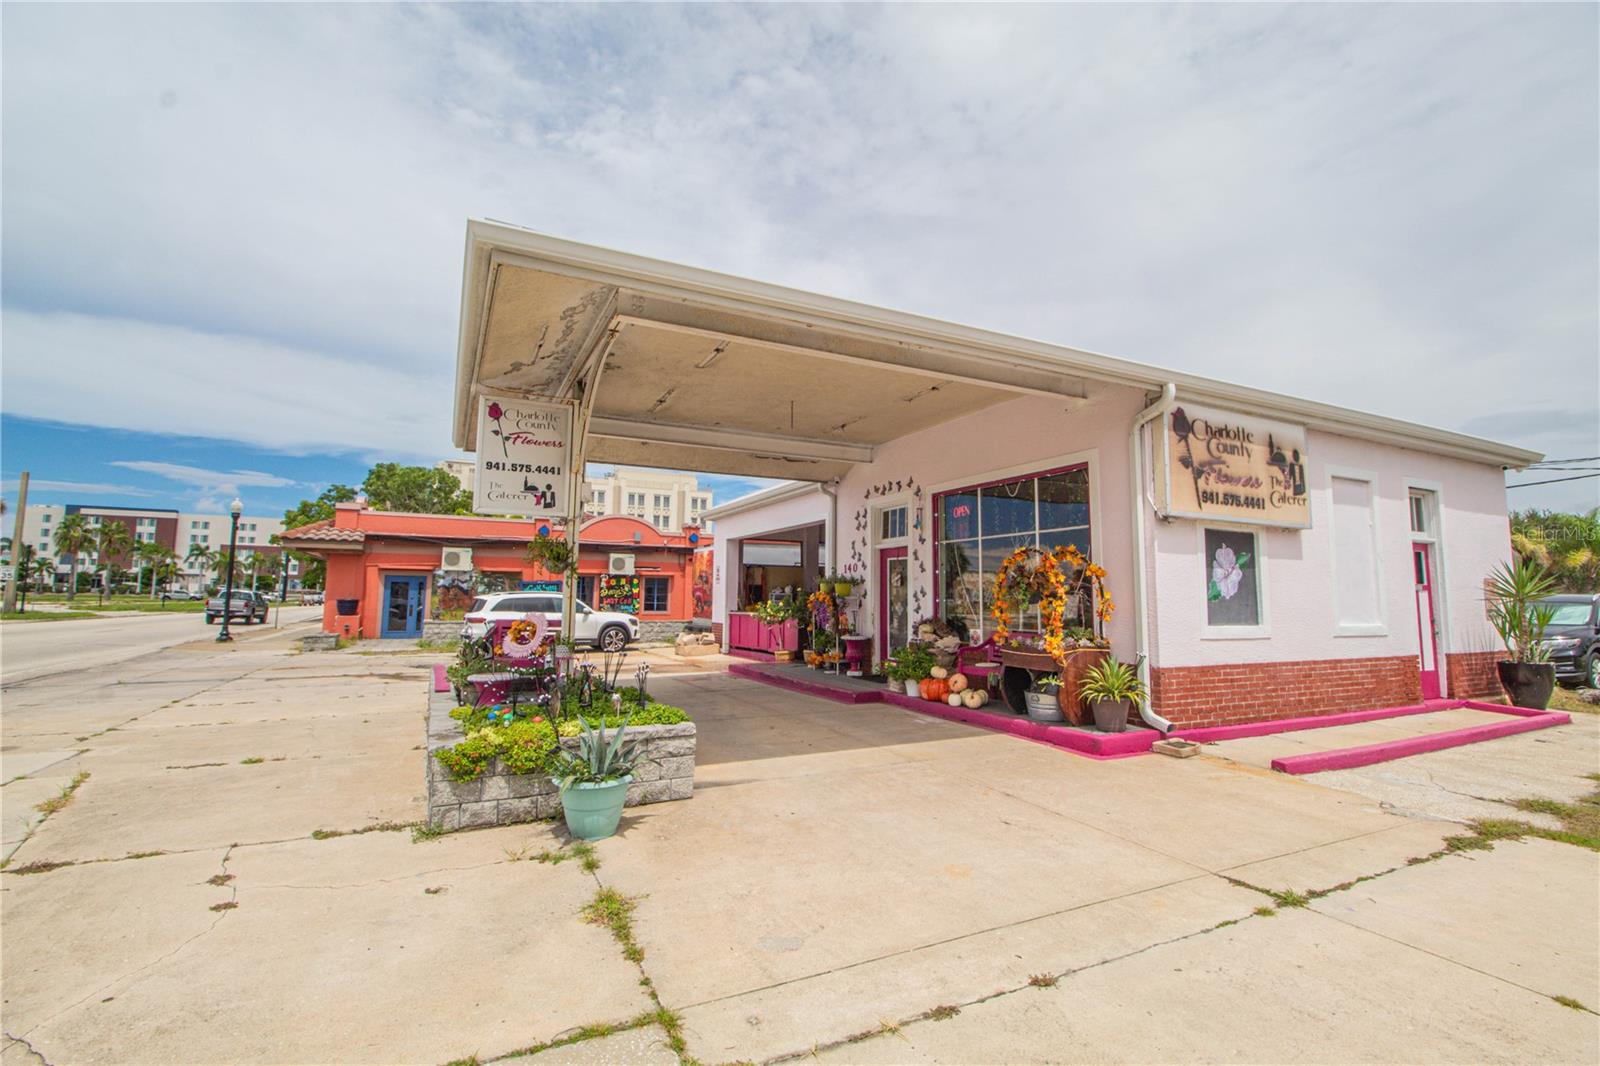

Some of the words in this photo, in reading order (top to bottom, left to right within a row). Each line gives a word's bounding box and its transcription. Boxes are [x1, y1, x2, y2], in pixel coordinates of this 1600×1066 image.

[504, 408, 560, 422] Charlotte
[516, 419, 556, 431] County
[1191, 418, 1254, 443] Charlotte
[508, 431, 564, 448] Flowers
[1207, 436, 1252, 463] County
[485, 461, 561, 475] 941.575.4441
[489, 481, 502, 489] The
[1270, 475, 1283, 489] The
[487, 490, 528, 501] Caterer
[1201, 491, 1266, 510] 941.575.4441
[1269, 490, 1308, 509] Caterer
[953, 504, 970, 518] OPEN
[843, 563, 858, 574] 140
